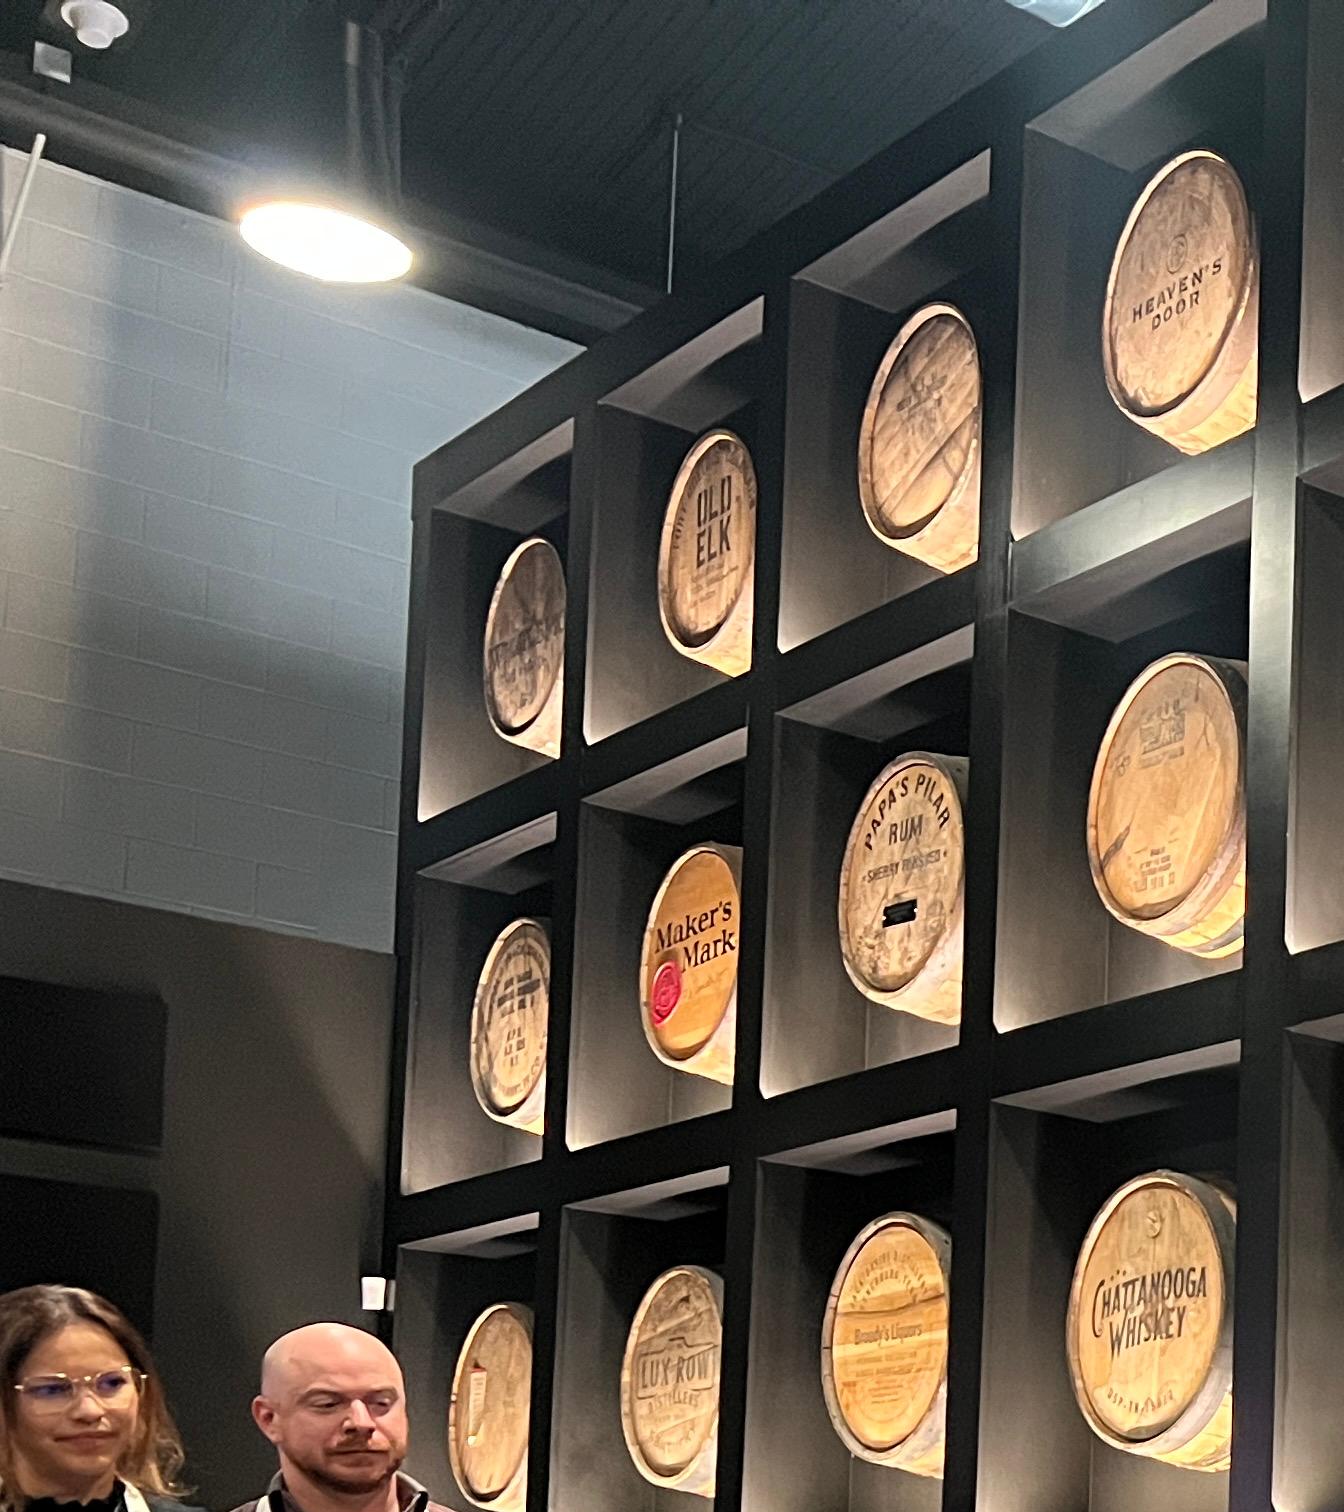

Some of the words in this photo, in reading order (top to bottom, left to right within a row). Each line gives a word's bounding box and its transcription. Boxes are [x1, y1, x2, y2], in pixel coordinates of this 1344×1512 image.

[1132, 256, 1223, 323] HEAVEN'S
[1152, 291, 1200, 331] DOOR
[696, 474, 732, 528] OLD
[696, 514, 732, 569] ELK
[863, 775, 910, 852] PAPA'S
[914, 772, 951, 831] PILAR
[888, 813, 925, 847] RUM
[653, 900, 733, 955] Maker's
[681, 929, 737, 974] Mark
[1092, 1266, 1207, 1338] CHATTANOOGA
[1109, 1305, 1187, 1361] WHISKEY
[641, 1356, 670, 1389] LUX
[676, 1349, 709, 1384] ROW
